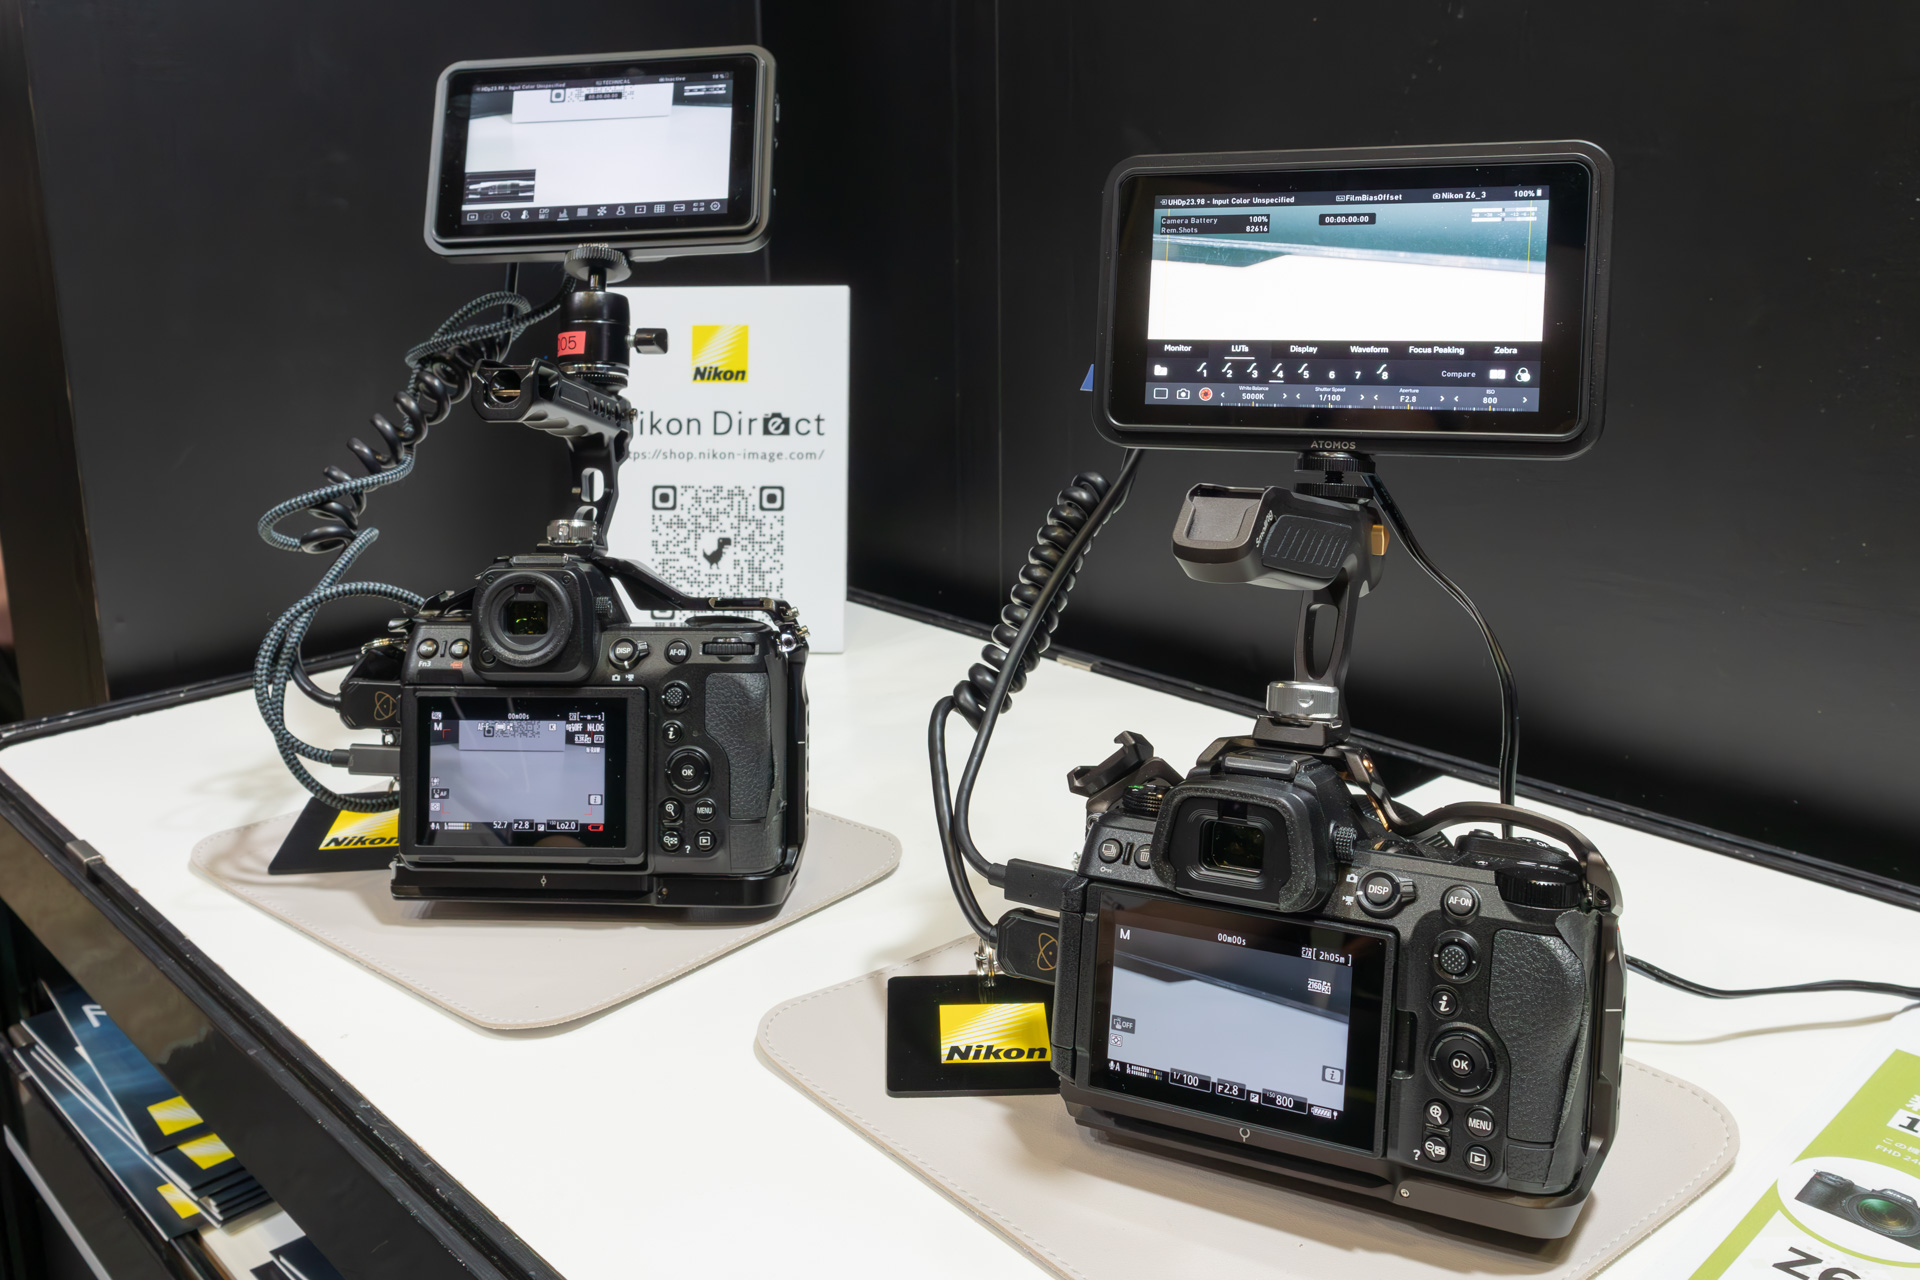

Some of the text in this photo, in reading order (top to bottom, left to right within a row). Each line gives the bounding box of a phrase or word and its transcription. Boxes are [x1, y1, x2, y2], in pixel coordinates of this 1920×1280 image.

[1466, 191, 1487, 200] Z6_3
[1514, 190, 1535, 198] 100%
[1168, 198, 1205, 206] UHDp23.98
[1212, 198, 1229, 206] Input
[1252, 196, 1295, 205] Unspecified
[1161, 217, 1188, 225] Camera
[1191, 217, 1218, 225] Battery
[1325, 216, 1369, 224] 00:00:00:00
[1161, 225, 1268, 234] Rem.Shots 82616
[558, 336, 577, 351] 05
[1164, 344, 1192, 352] Monitor
[1290, 345, 1318, 354] Display
[1409, 346, 1465, 355] Focus Peaking
[693, 366, 746, 382] Nikon
[1252, 370, 1258, 378] 3
[1277, 370, 1284, 378] 4
[1303, 371, 1309, 379] 5
[1329, 371, 1336, 379] 6
[1355, 371, 1361, 379] 7
[1381, 371, 1388, 380] 8
[1441, 371, 1476, 379] Compare
[1319, 394, 1341, 402] 1/100
[639, 411, 701, 436] ikon
[1310, 440, 1356, 450] ATOMOS
[616, 646, 631, 655] DISP
[669, 648, 686, 657] AF-ON
[433, 722, 443, 731] M
[696, 806, 713, 815] MENU
[514, 821, 530, 829] F2.8
[556, 822, 576, 830] Lo2.0
[323, 835, 399, 847] Nikon
[1368, 884, 1389, 895] DISP
[1448, 896, 1472, 907] AF-ON
[1119, 928, 1131, 940] M
[1218, 933, 1246, 946] 00m00s
[1319, 951, 1345, 964] 2h05m
[1307, 980, 1322, 990] 2160
[1121, 1021, 1133, 1029] OFF
[945, 1045, 1048, 1061] Nikon
[1453, 1058, 1468, 1071] OK
[1173, 1071, 1199, 1087] 1/100
[1218, 1083, 1239, 1096] F2.8
[1275, 1094, 1294, 1108] 800
[1468, 1117, 1492, 1131] MENU
[1875, 1144, 1920, 1166] FHD 24
